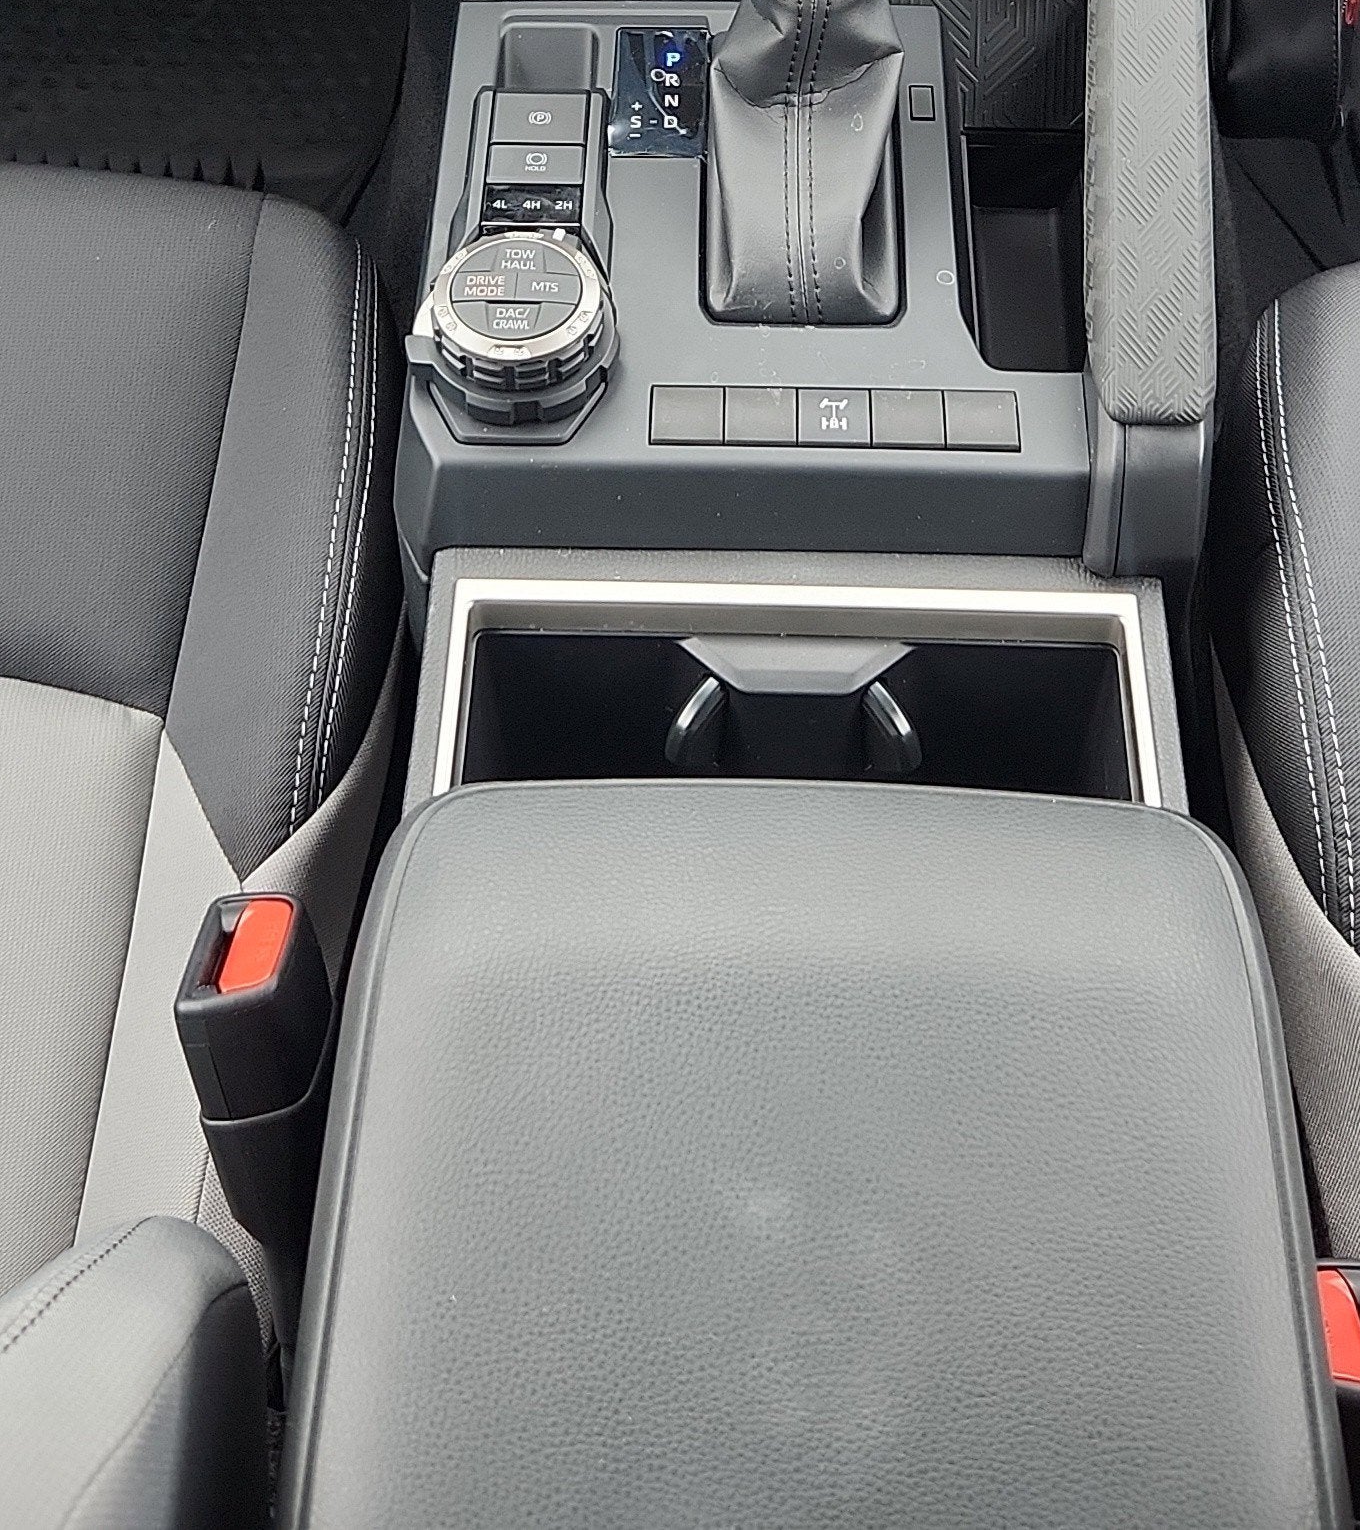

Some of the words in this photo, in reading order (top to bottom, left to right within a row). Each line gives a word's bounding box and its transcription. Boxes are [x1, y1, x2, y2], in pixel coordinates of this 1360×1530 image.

[666, 52, 681, 66] P
[664, 72, 680, 87] R
[664, 94, 680, 107] N
[630, 115, 642, 128] S
[663, 115, 678, 128] D
[524, 164, 546, 172] HOLD
[492, 200, 508, 210] 4L
[522, 200, 541, 210] 4H
[554, 199, 573, 210] 2H
[505, 248, 535, 259] TOW
[501, 259, 536, 270] HAUL
[465, 274, 506, 286] DRIVE
[464, 284, 505, 297] MODE
[530, 281, 559, 293] MTS
[496, 306, 530, 319] DAC/
[492, 318, 531, 330] CRAWL
